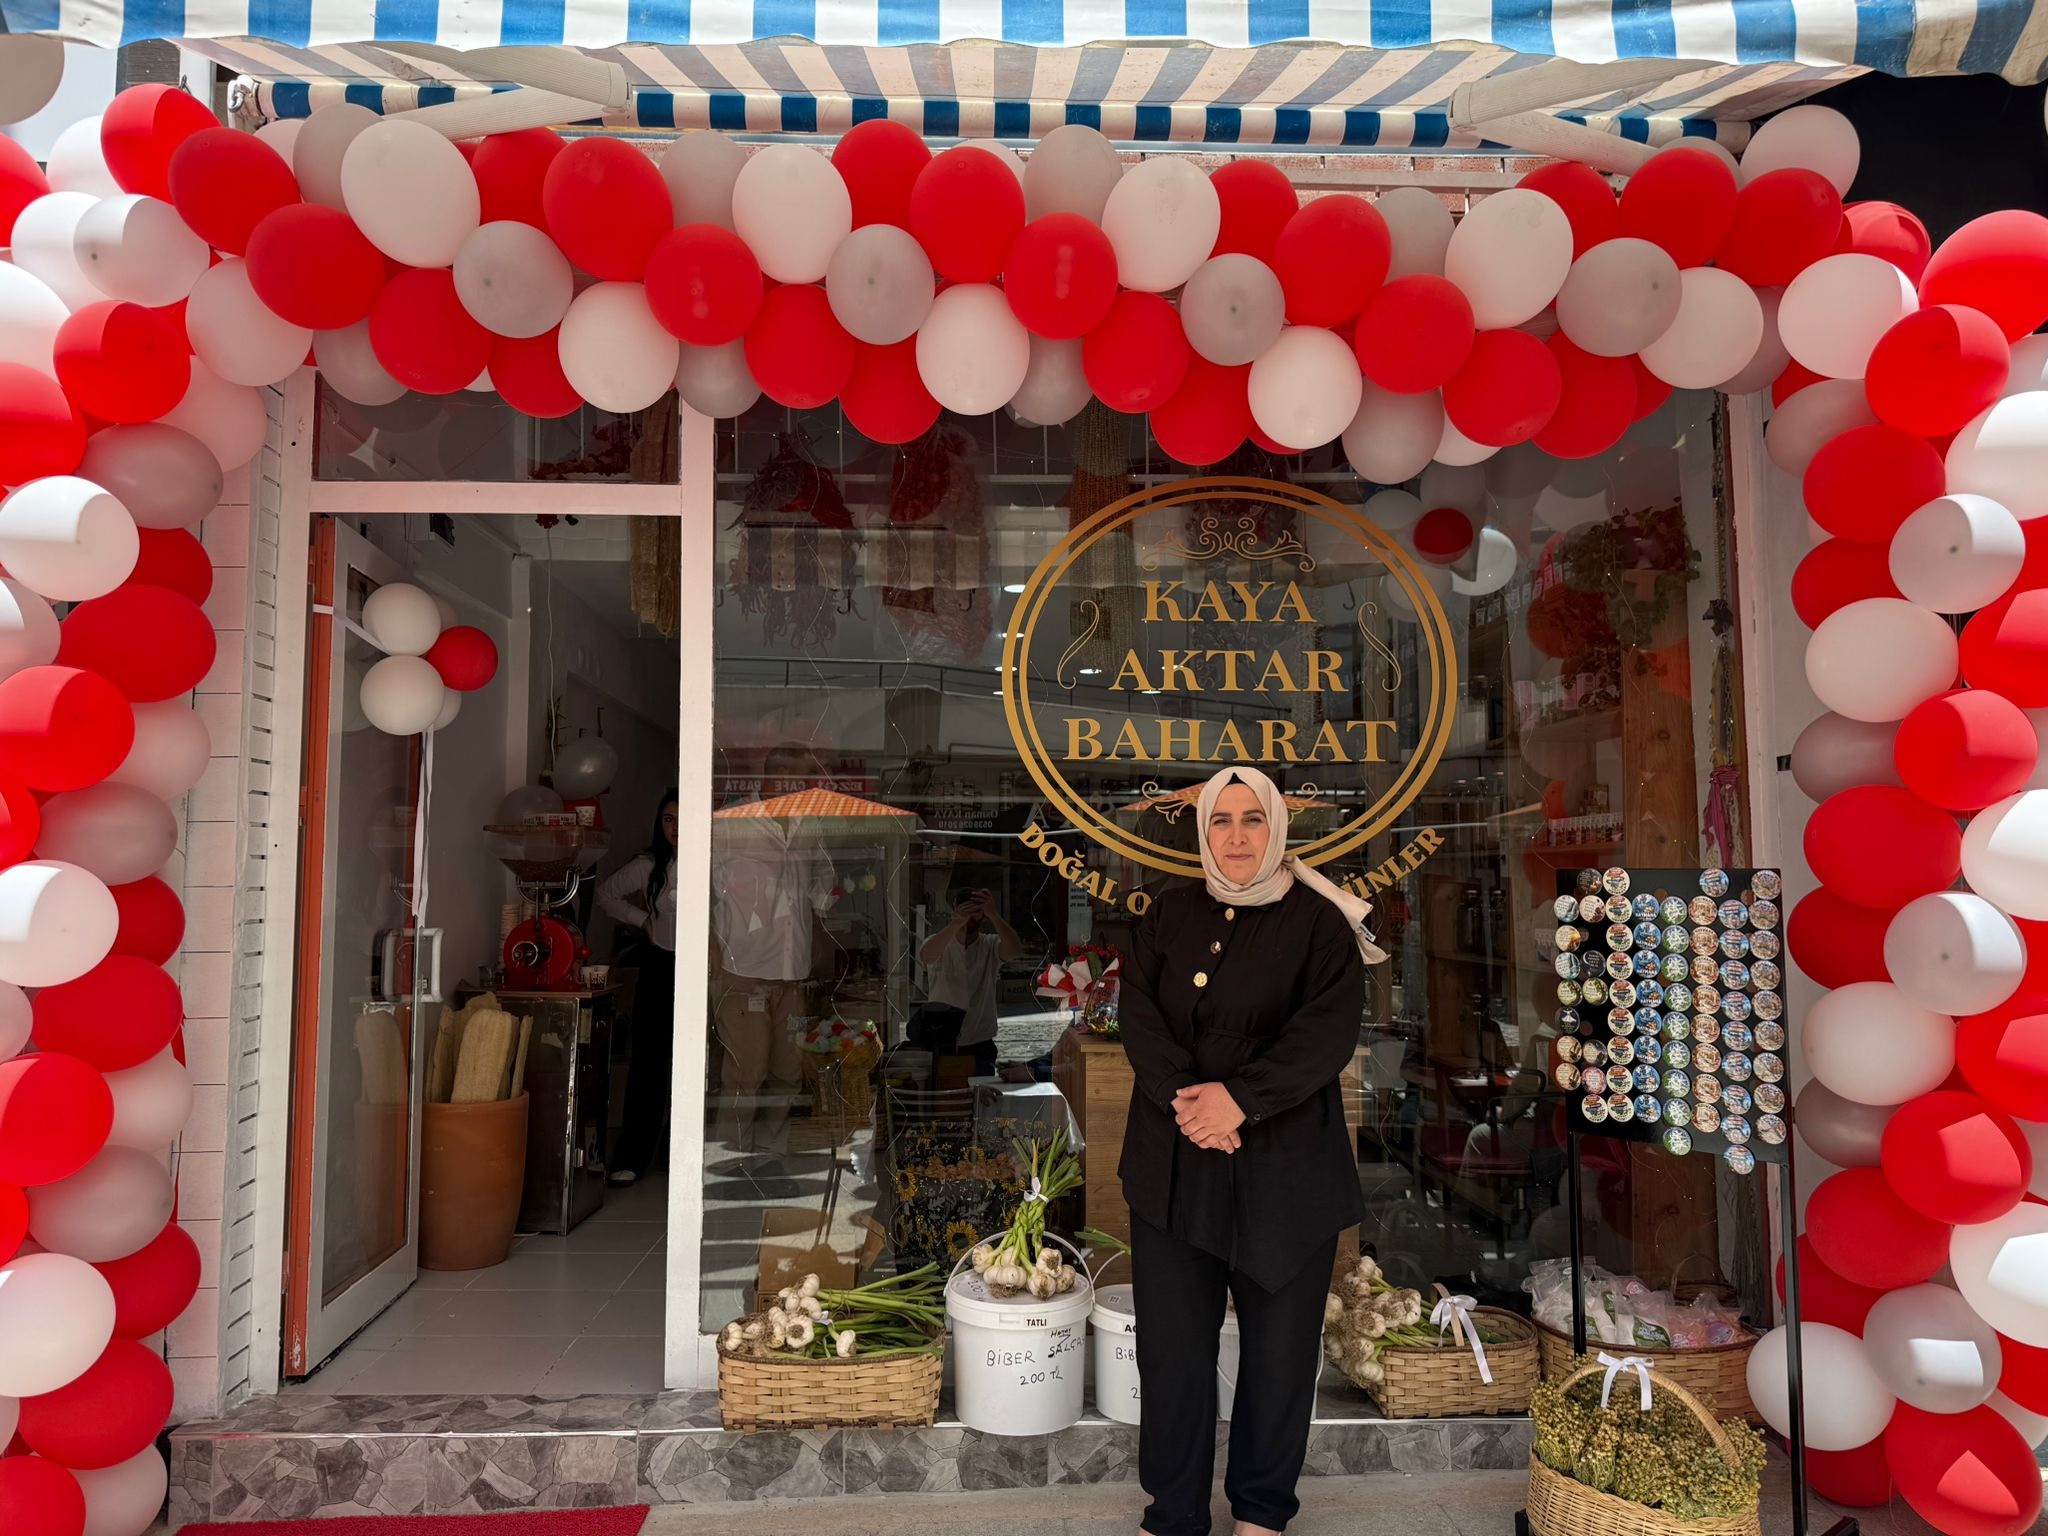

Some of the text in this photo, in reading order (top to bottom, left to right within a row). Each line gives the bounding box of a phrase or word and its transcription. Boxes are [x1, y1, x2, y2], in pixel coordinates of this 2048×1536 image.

[1141, 580, 1317, 623] KAYA
[1108, 649, 1349, 692] AKTAR
[1063, 718, 1397, 762] BAHARAT
[1018, 821, 1445, 905] DOĞAL ÜNLER
[1026, 1318, 1047, 1327] TATLI
[1020, 1371, 1046, 1386] 200
